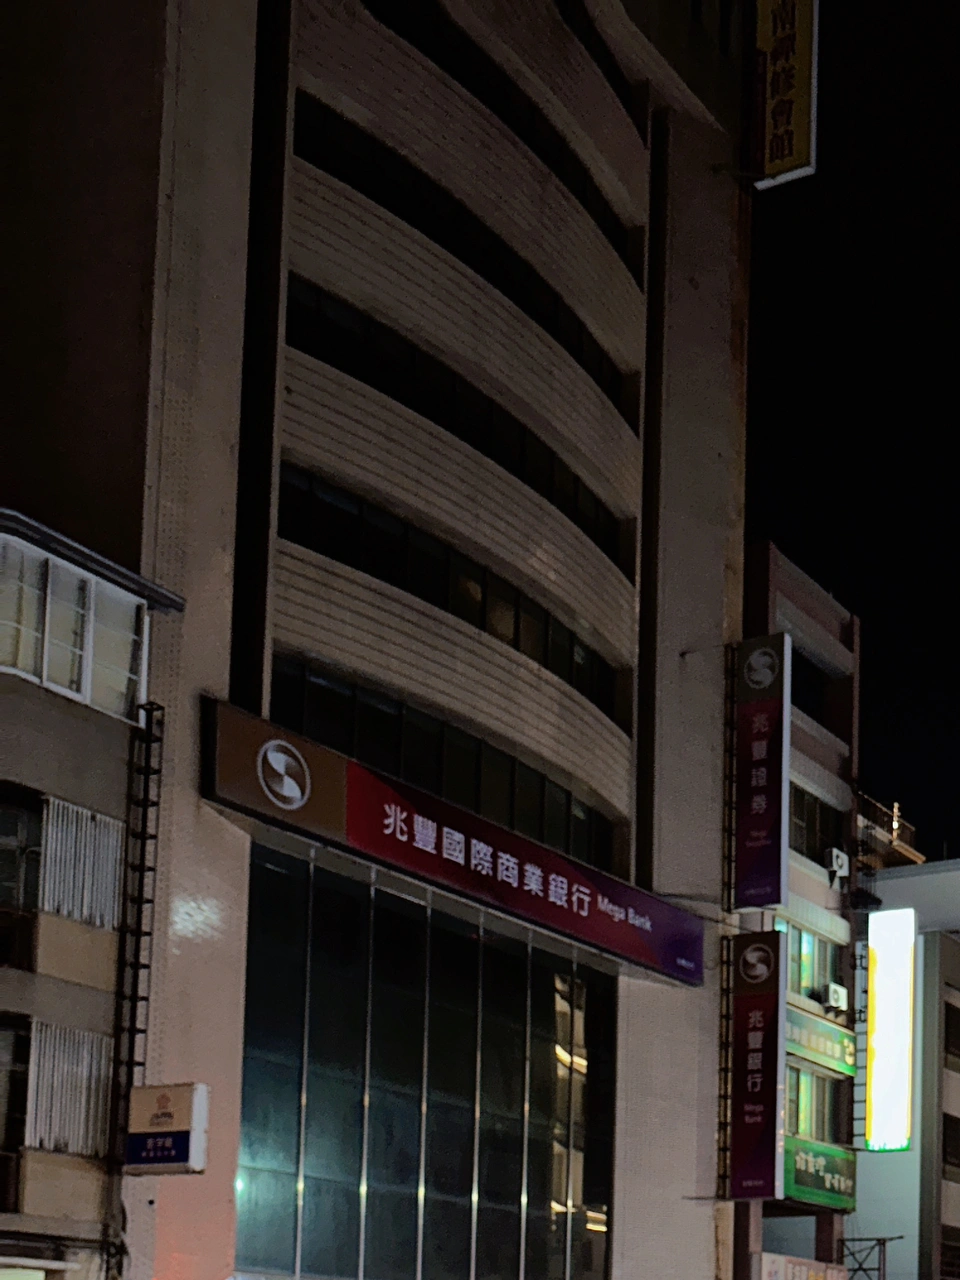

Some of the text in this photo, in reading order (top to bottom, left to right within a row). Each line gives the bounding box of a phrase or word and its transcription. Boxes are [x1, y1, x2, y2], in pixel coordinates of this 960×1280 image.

[383, 803, 653, 932] 兆豐國際商業銀行 Mega Bank
